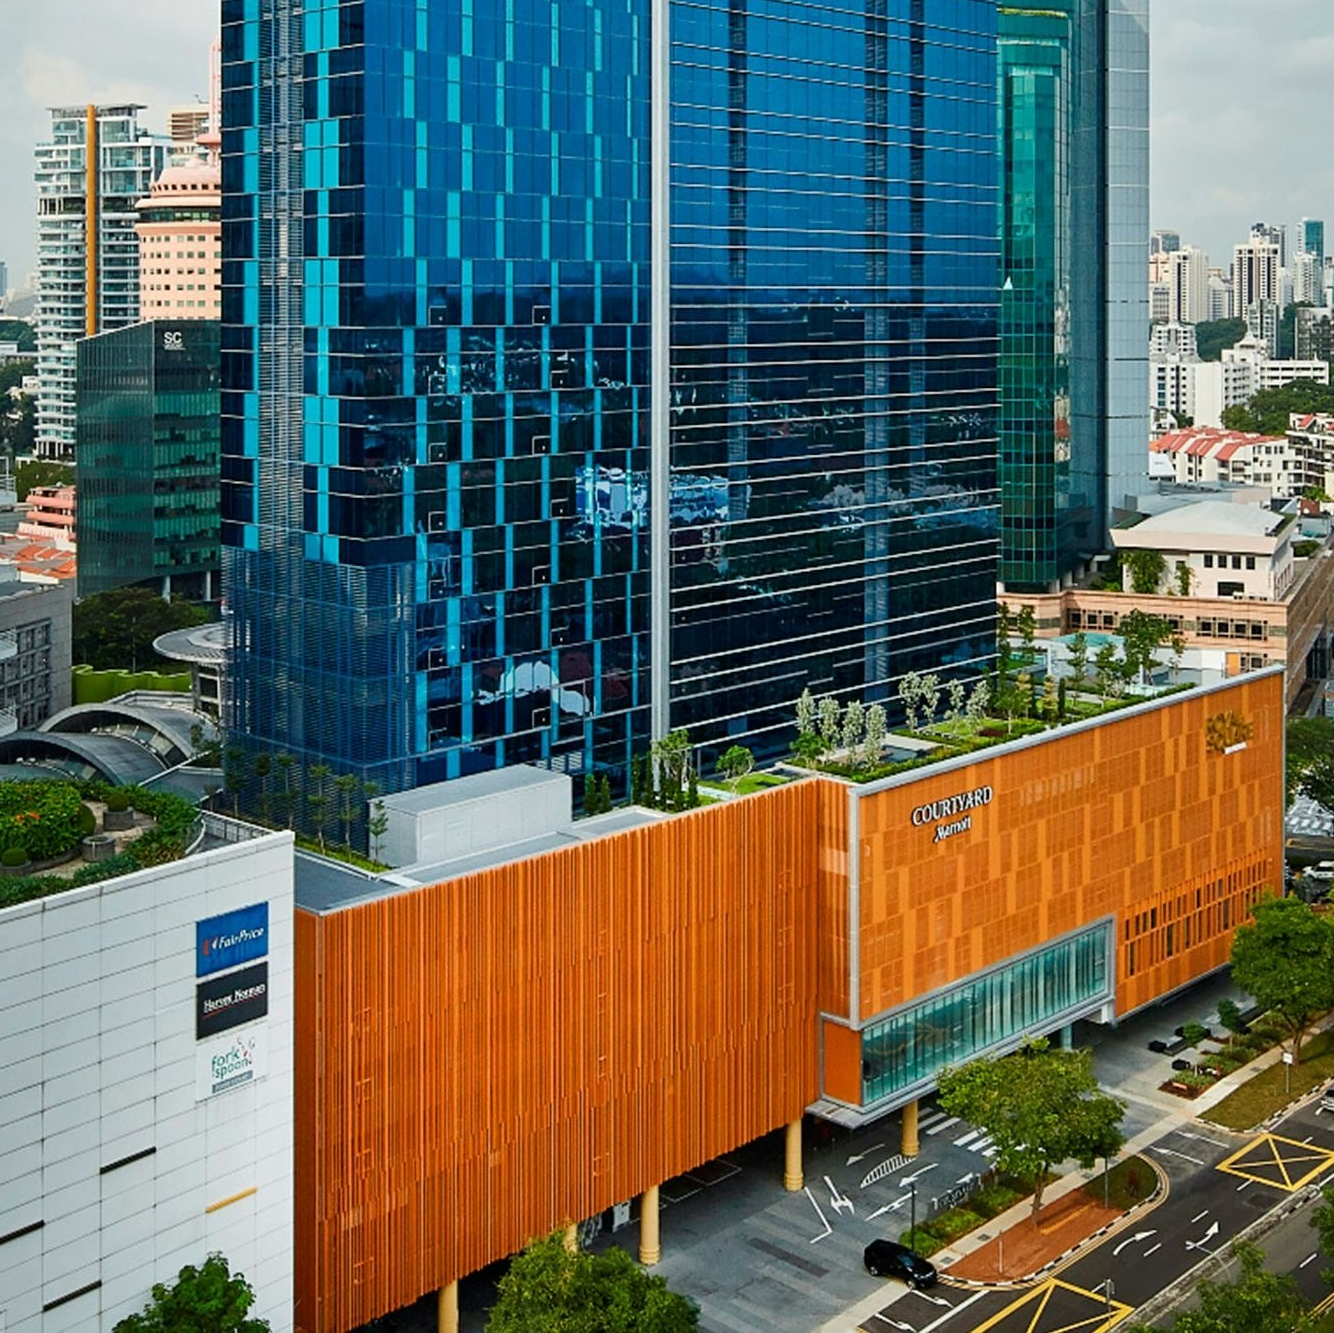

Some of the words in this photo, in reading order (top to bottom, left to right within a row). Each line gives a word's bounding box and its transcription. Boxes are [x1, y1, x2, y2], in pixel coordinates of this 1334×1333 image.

[163, 331, 182, 344] SC
[912, 785, 993, 826] COURTYARD
[218, 927, 264, 949] FairPrice
